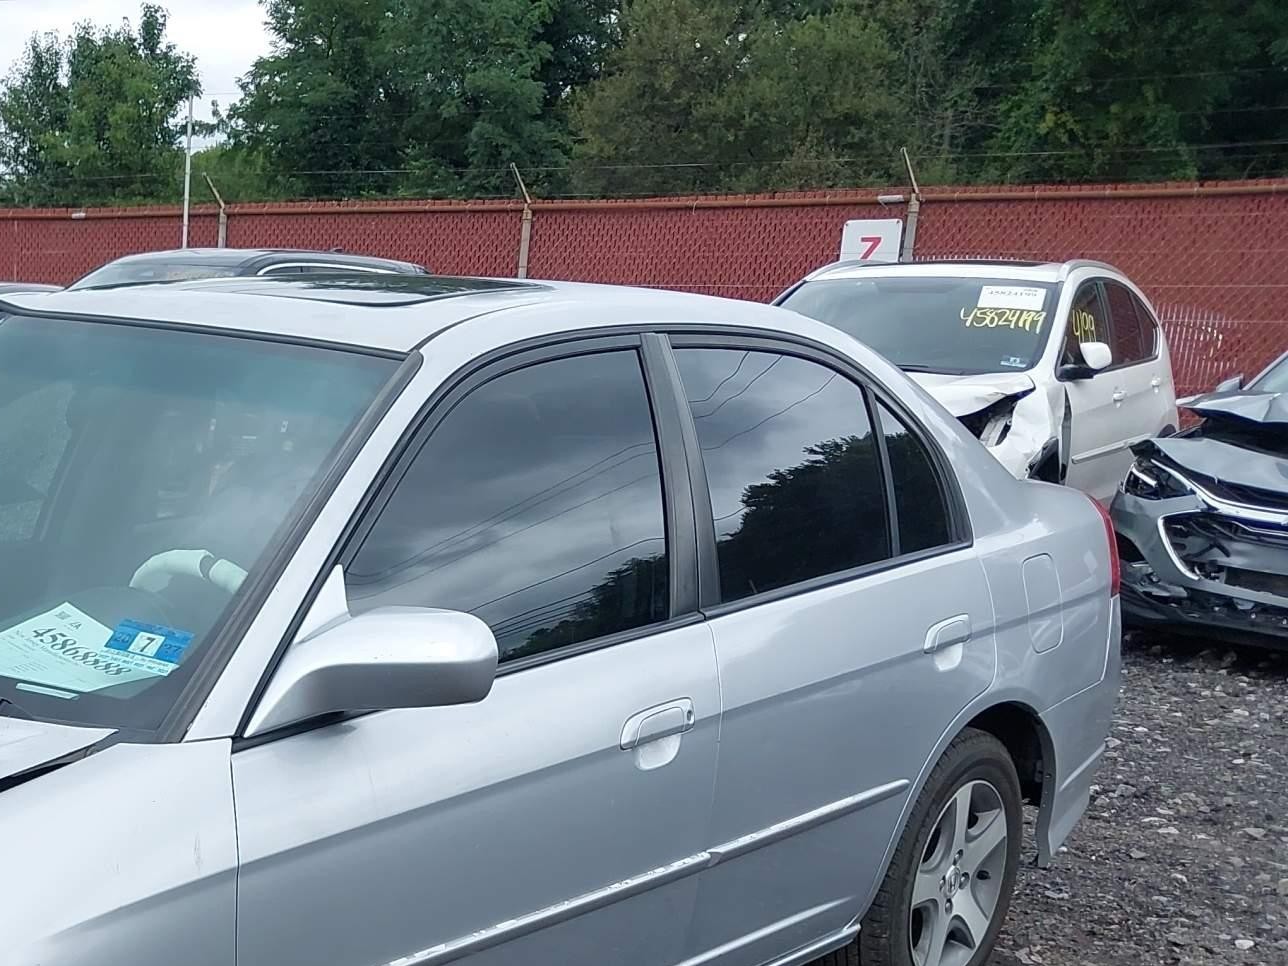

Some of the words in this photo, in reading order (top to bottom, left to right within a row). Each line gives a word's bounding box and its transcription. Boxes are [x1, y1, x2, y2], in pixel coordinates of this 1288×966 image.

[860, 236, 882, 260] 7
[960, 307, 1046, 334] 45824199
[32, 627, 132, 676] 45868888
[141, 636, 156, 652] 7
